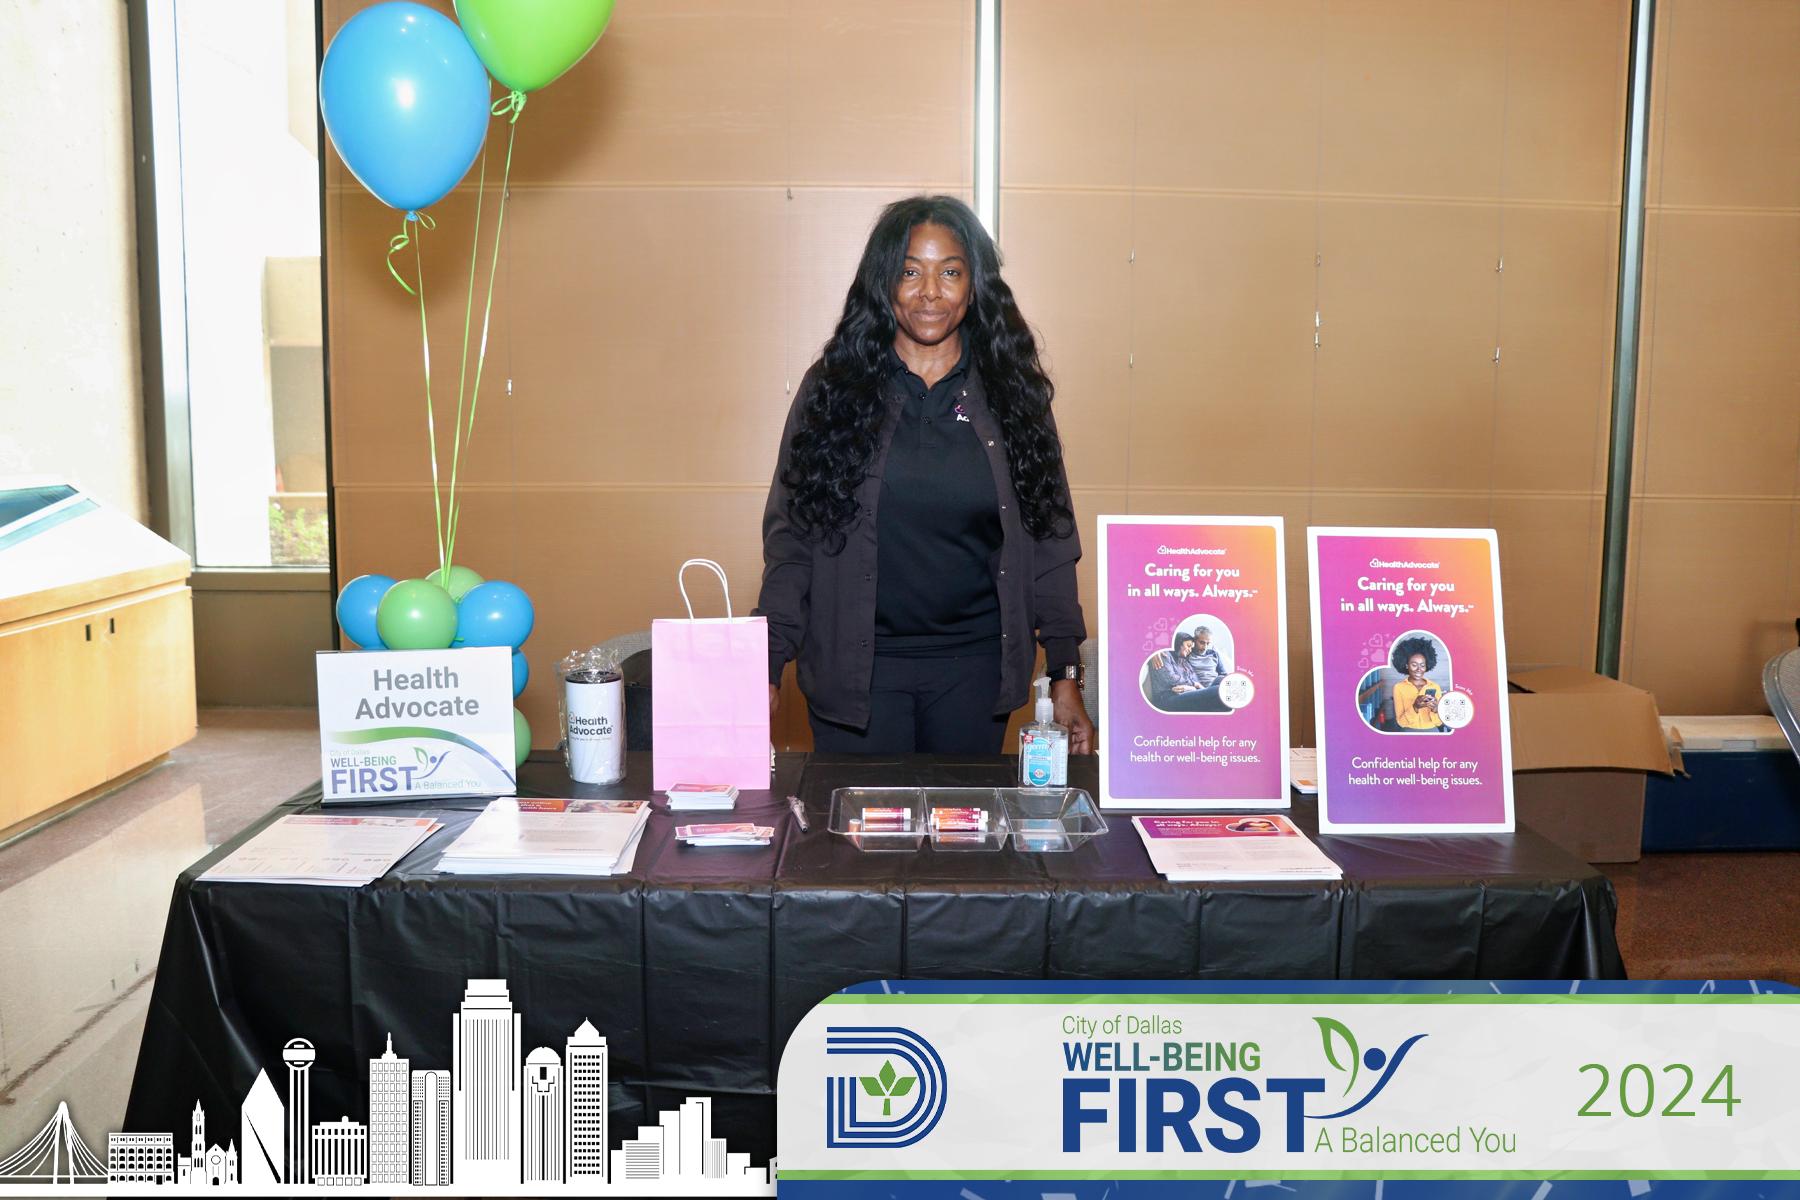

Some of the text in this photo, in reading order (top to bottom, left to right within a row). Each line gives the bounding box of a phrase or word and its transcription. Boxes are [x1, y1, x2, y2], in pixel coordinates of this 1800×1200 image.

[1144, 563, 1240, 582] Caring for you
[1127, 584, 1140, 597] in
[1144, 583, 1160, 597] all
[1163, 588, 1199, 602] ways.
[1357, 576, 1455, 597] Caring for you
[1340, 598, 1354, 612] in
[1358, 597, 1374, 612] all
[1377, 602, 1414, 617] ways.
[373, 666, 459, 691] Health
[355, 696, 480, 720] Advocate
[575, 716, 608, 726] Health
[570, 725, 612, 736] Advocate
[1133, 735, 1257, 751] Confidential help for any
[330, 756, 397, 768] WELL-BEING
[1130, 751, 1261, 767] health or well-being issues.
[1352, 756, 1478, 773] Confidential help for any
[331, 766, 418, 794] FIRST
[1348, 773, 1482, 789] health or well-being issues.
